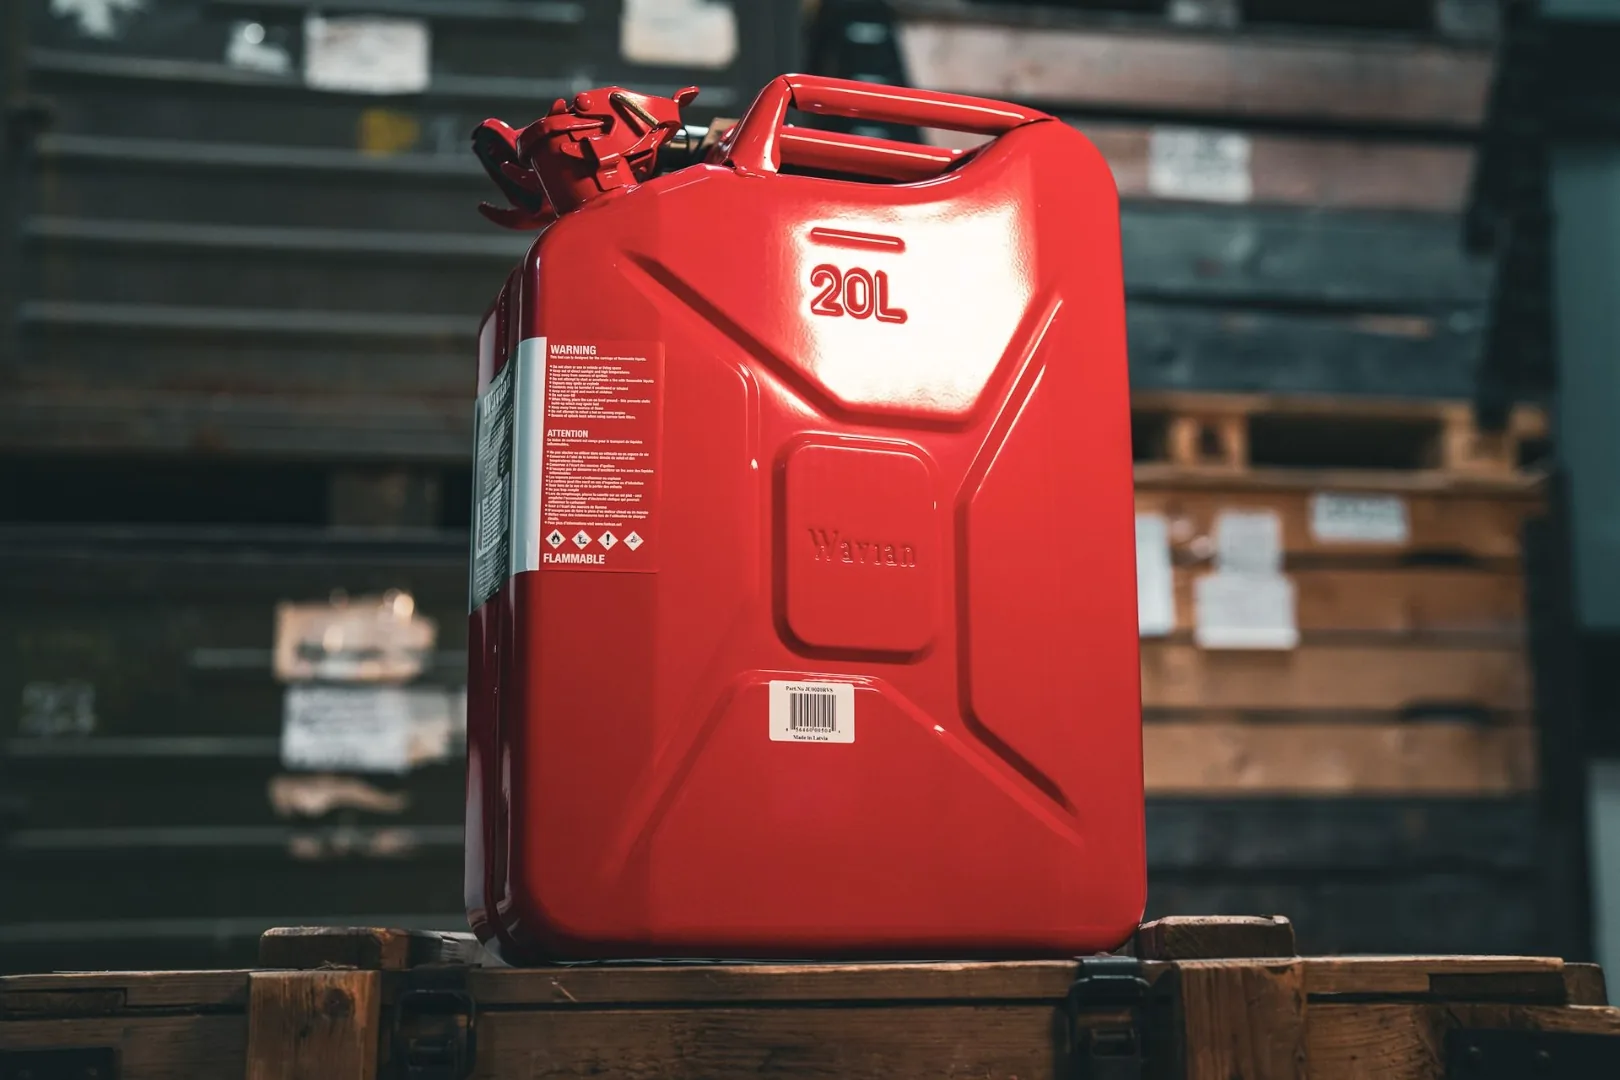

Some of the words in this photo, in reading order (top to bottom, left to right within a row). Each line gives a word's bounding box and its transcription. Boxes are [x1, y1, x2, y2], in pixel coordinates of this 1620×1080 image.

[811, 264, 908, 324] 20L
[550, 344, 596, 355] WARNING
[547, 429, 588, 438] ATTENTION
[808, 527, 916, 568] Wavian
[544, 552, 605, 564] FLAMMABLE
